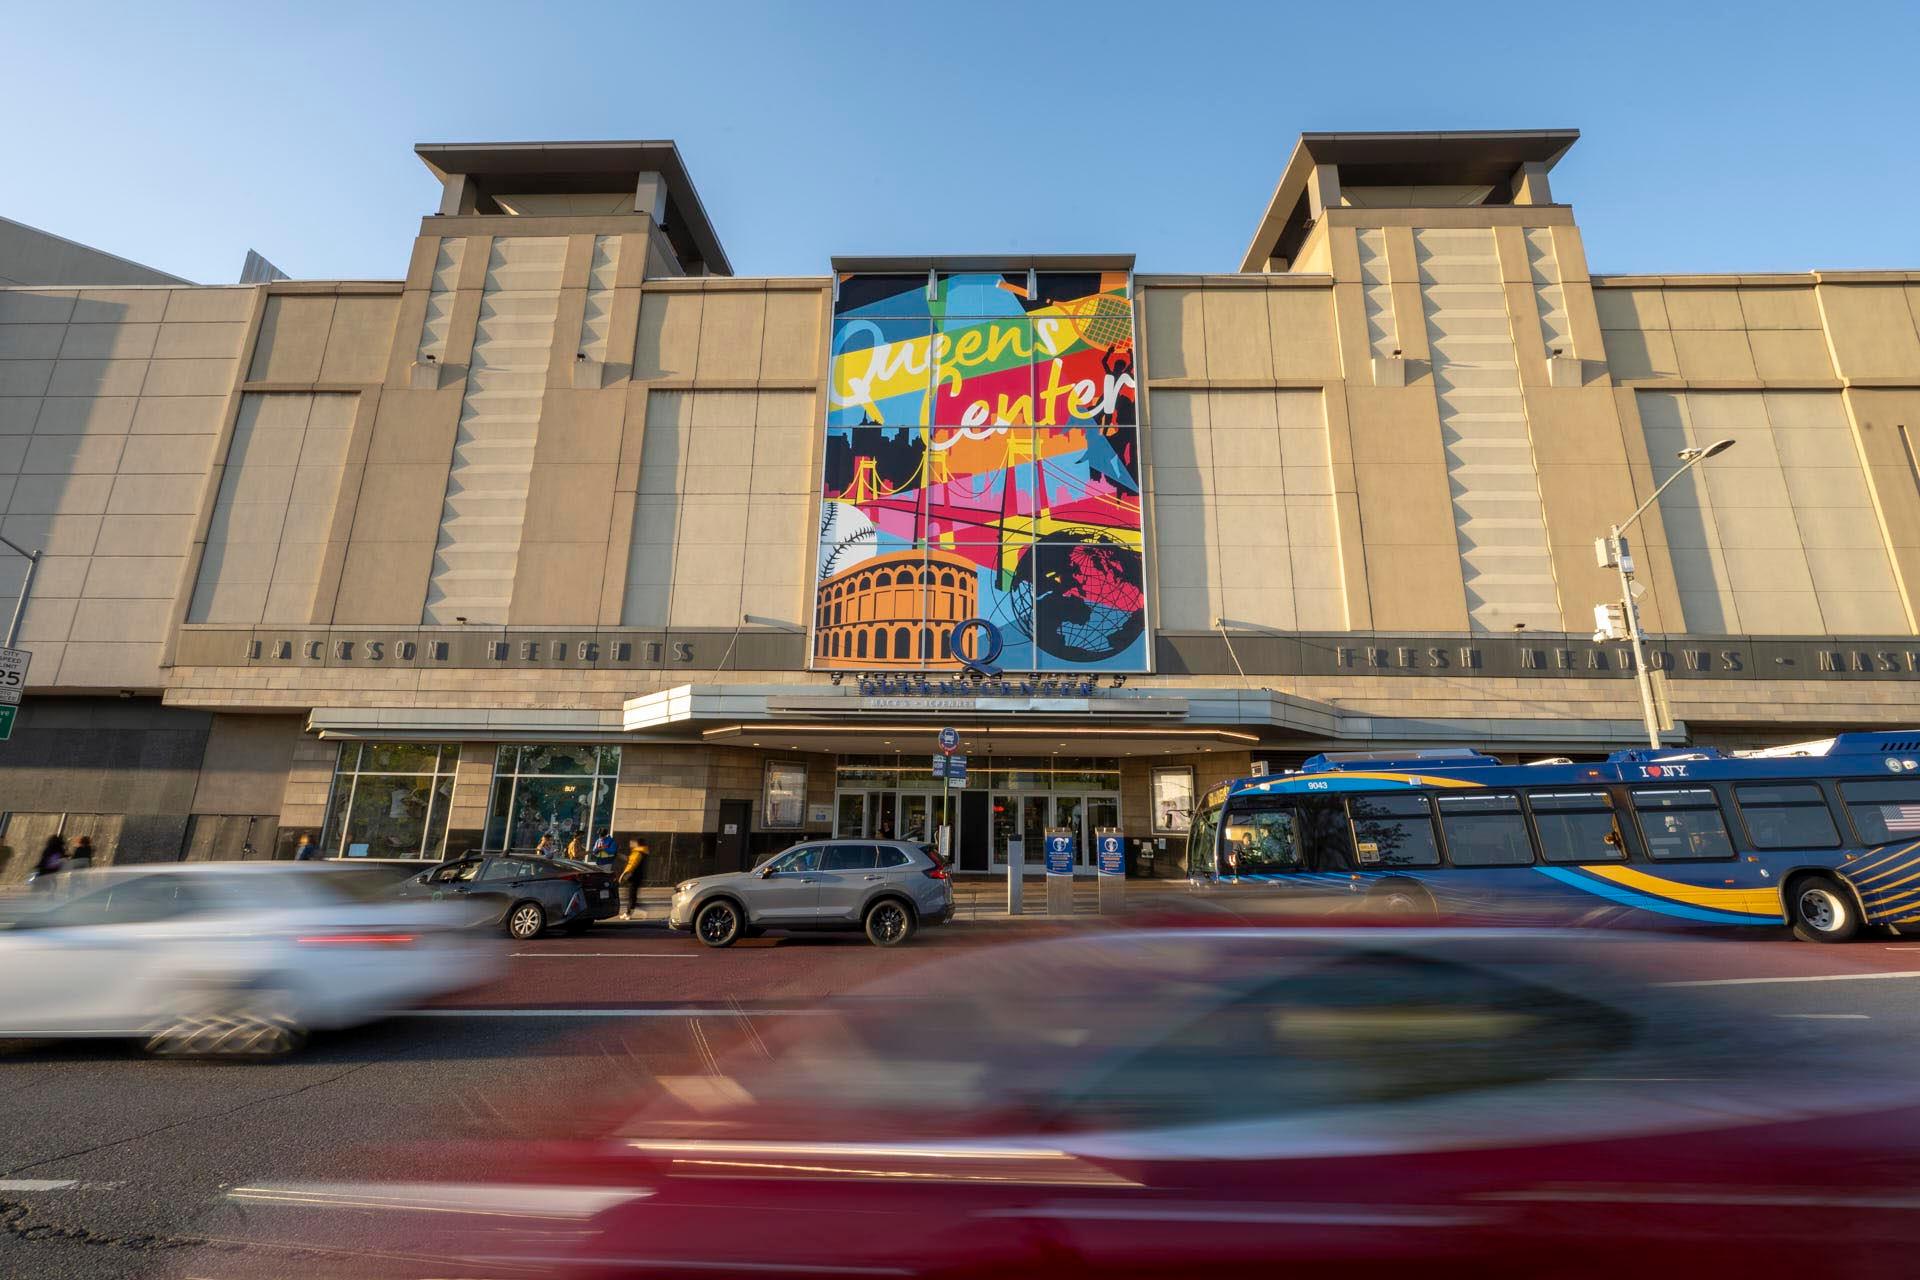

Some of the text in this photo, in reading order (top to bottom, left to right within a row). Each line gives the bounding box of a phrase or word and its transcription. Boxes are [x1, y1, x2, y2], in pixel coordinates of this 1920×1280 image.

[829, 318, 1058, 425] Queens
[920, 358, 1135, 451] Center
[242, 639, 684, 662] JACKSON HEIGHTS
[949, 619, 1003, 679] Q
[1337, 646, 1473, 668] FRESH
[1520, 647, 1736, 671] MEADOWS
[1639, 765, 1687, 778] I NY
[1307, 781, 1329, 790] 9043
